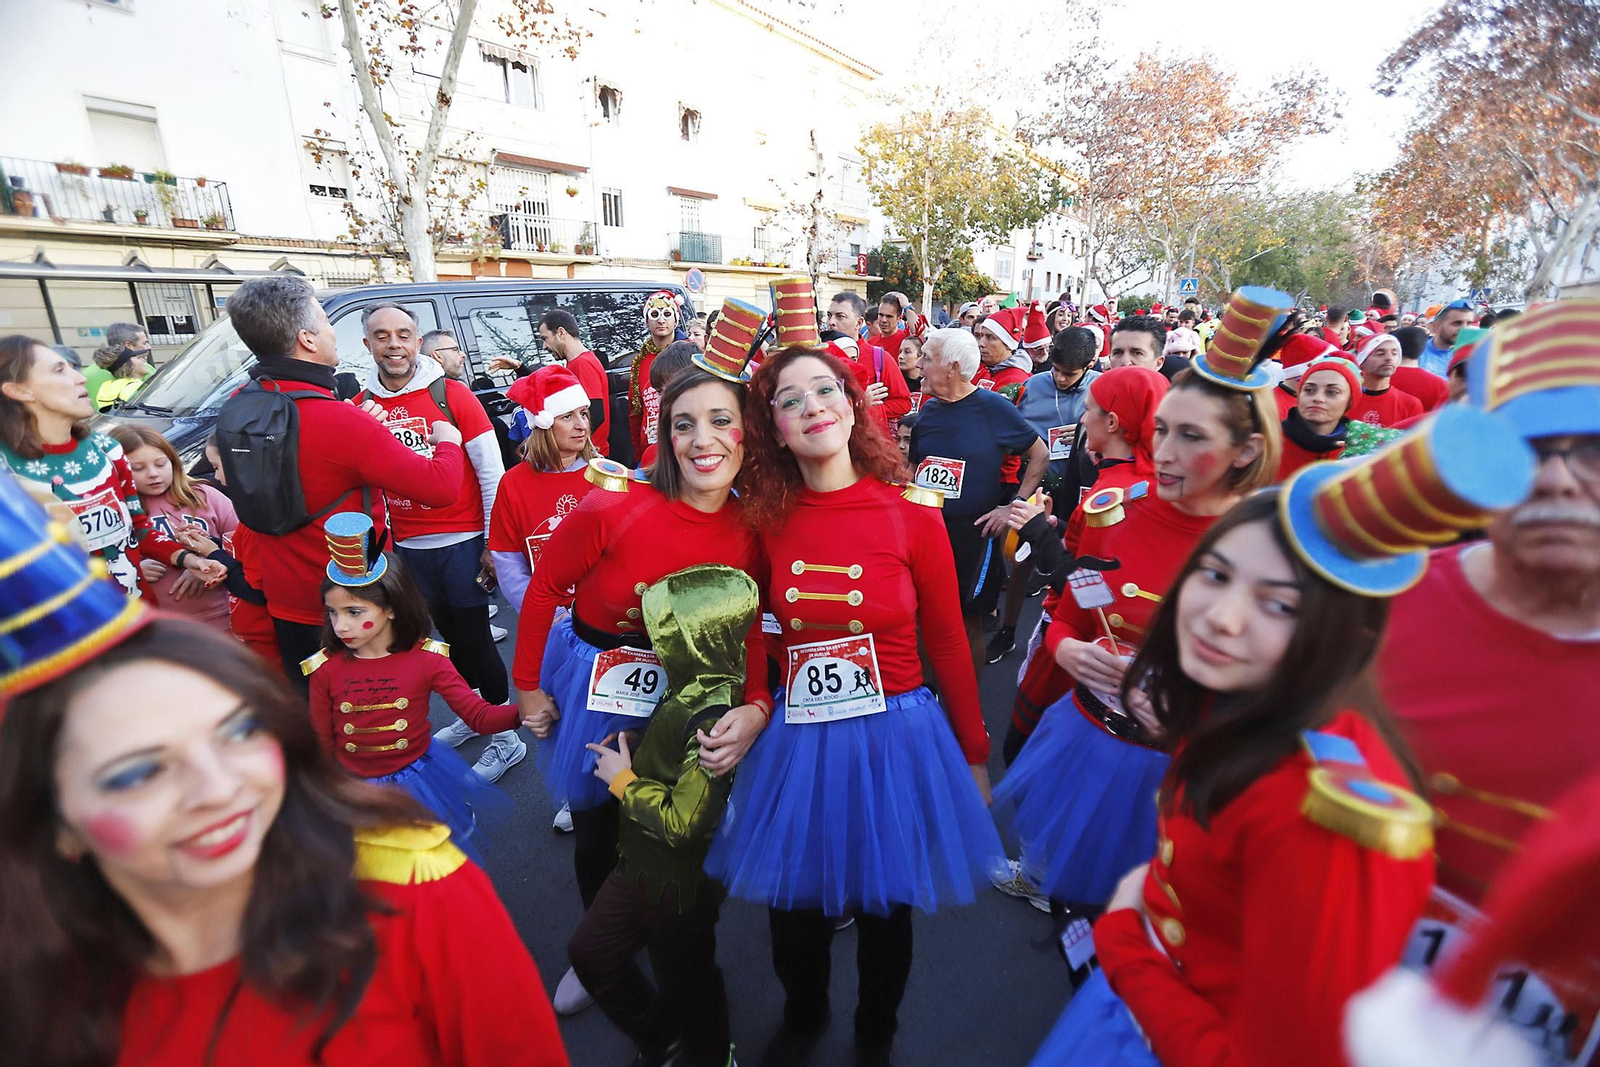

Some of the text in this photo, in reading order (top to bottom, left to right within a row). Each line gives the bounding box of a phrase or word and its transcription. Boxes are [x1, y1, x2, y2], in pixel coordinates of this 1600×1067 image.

[925, 467, 948, 485] 182
[78, 508, 113, 535] 570
[624, 667, 658, 695] 49
[807, 663, 842, 696] 85
